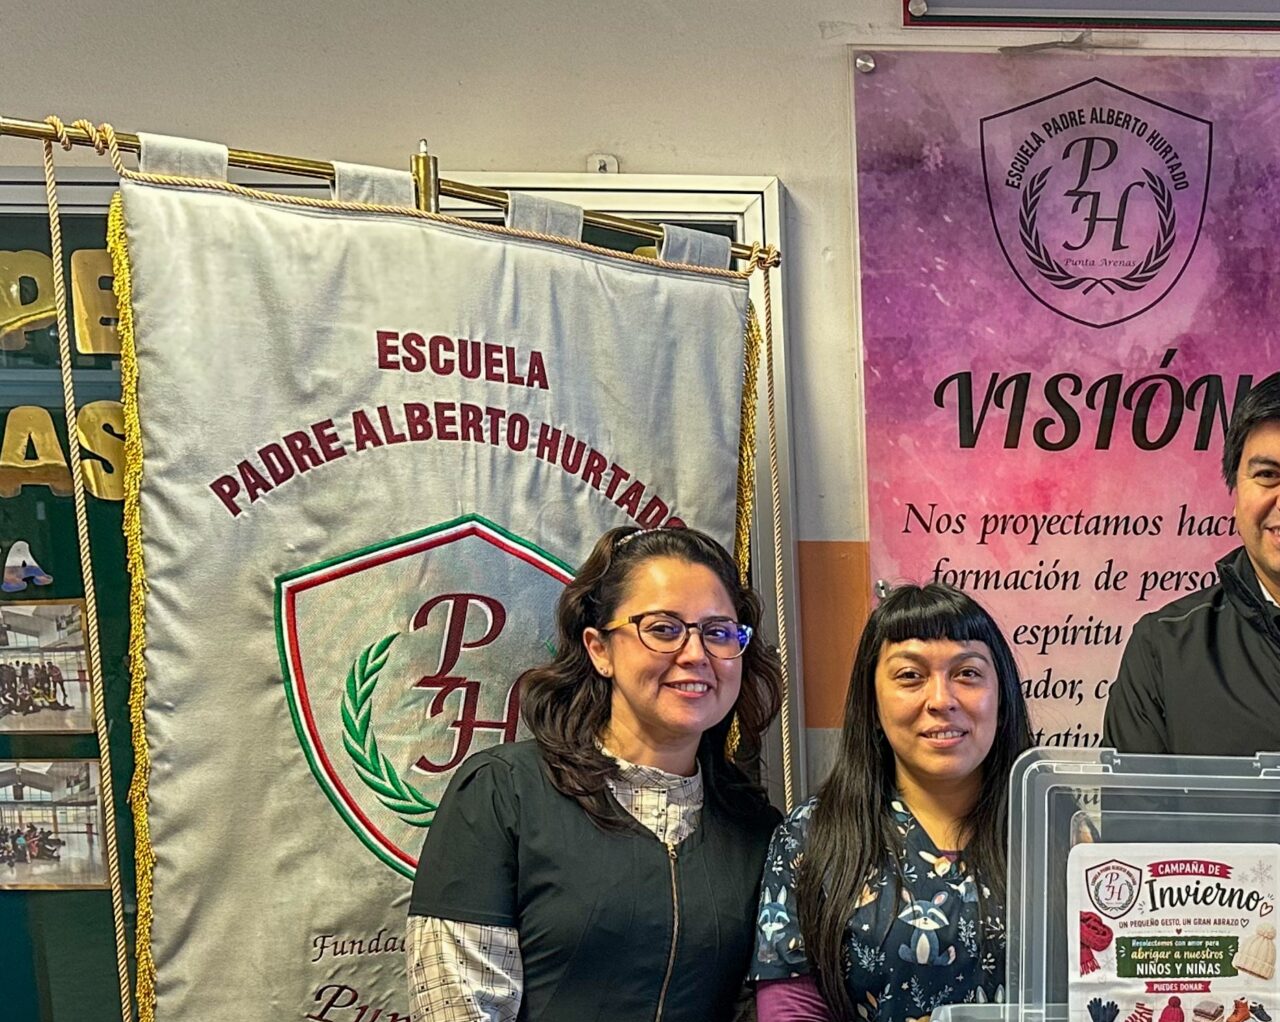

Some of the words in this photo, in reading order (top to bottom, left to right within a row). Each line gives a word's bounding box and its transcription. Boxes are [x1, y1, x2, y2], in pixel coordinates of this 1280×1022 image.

[1004, 130, 1046, 190] ESCUELA
[1042, 108, 1086, 138] PADRE
[1089, 107, 1149, 139] ALBERTO
[1146, 129, 1190, 191] HURTADO
[1064, 257, 1096, 267] Punta
[1099, 257, 1137, 268] Arenas
[376, 330, 550, 391] ESCUELA
[209, 418, 347, 518] PADRE
[351, 401, 530, 453] ALBERTO
[902, 503, 966, 536] Nos
[976, 509, 1163, 546] proyectamos
[1176, 504, 1240, 537] haci
[932, 557, 1081, 592] formación
[1094, 559, 1129, 591] de
[1136, 567, 1222, 602] perso
[1012, 614, 1123, 655] espíritu
[1157, 861, 1206, 875] CAMPAÑA
[1208, 865, 1221, 876] DE
[1144, 878, 1264, 912] Invierno
[1119, 921, 1128, 929] UN
[1130, 918, 1160, 928] PEQUEÑO
[1213, 918, 1239, 927] ABRAZO
[1131, 947, 1171, 963] abrigar
[1174, 950, 1181, 959] a
[1183, 948, 1224, 960] nuestros
[1205, 941, 1220, 949] para
[1136, 961, 1171, 976] NIÑOS
[1175, 963, 1183, 975] Y
[1186, 961, 1221, 975] NIÑAS
[1153, 983, 1178, 992] PUEDES
